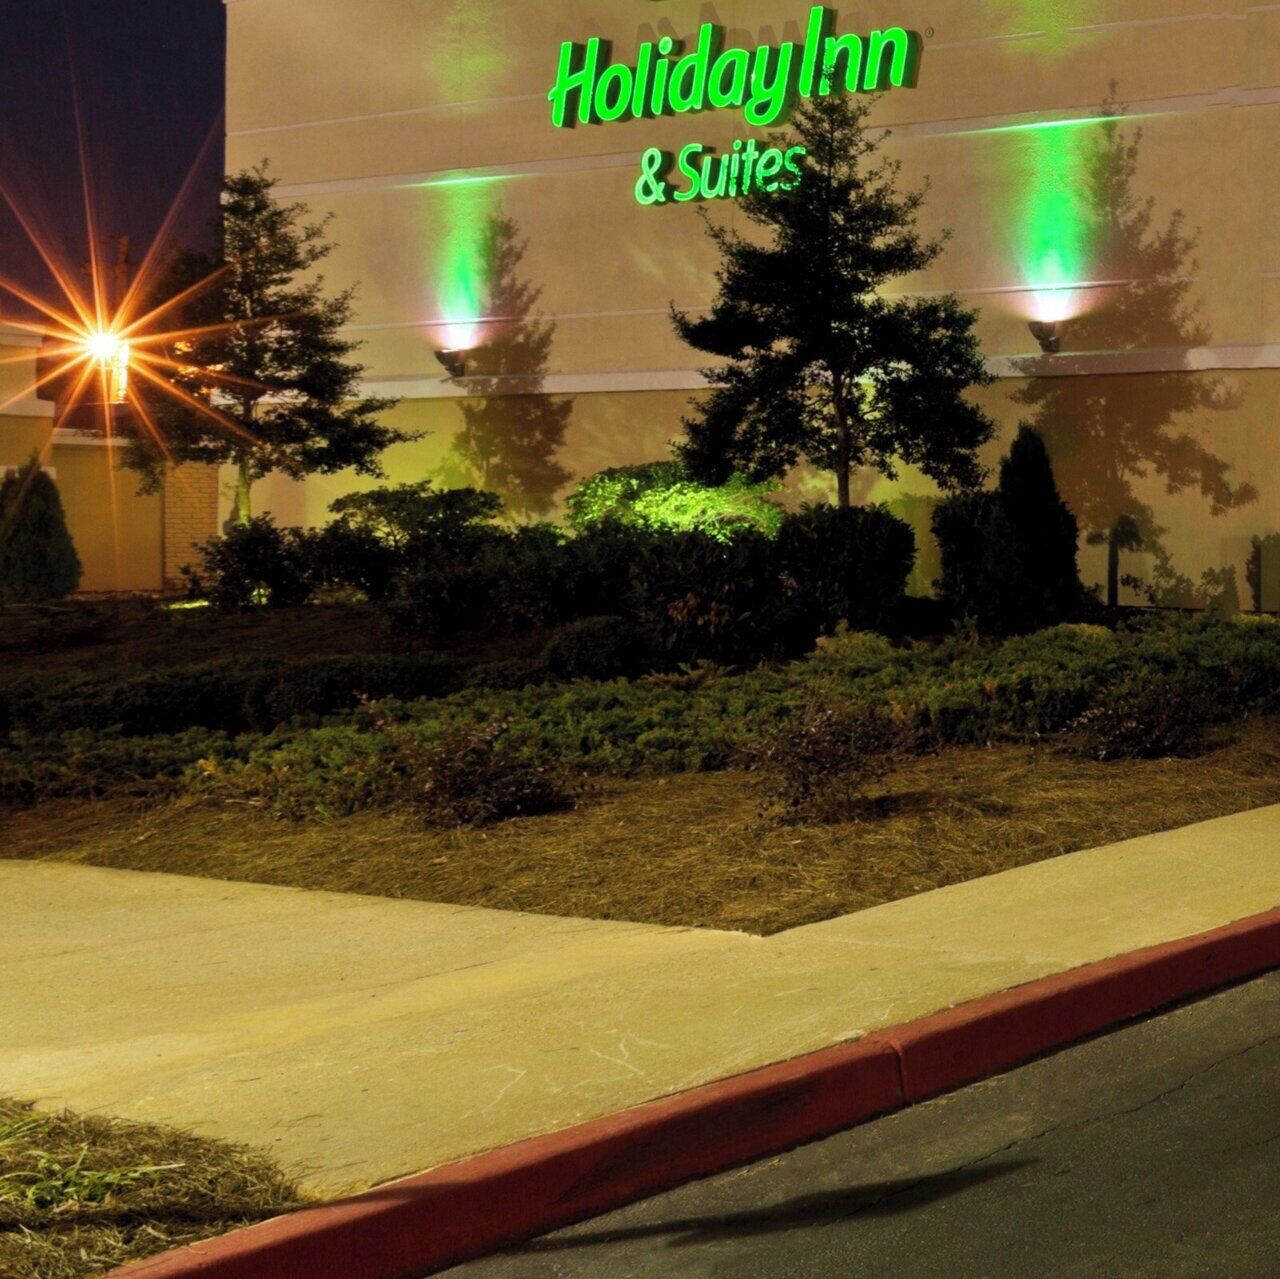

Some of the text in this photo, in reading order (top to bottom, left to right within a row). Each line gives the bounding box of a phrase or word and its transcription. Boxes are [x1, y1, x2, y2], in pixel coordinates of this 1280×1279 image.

[547, 5, 909, 127] Holiday Inn
[634, 138, 807, 205] & Suites
